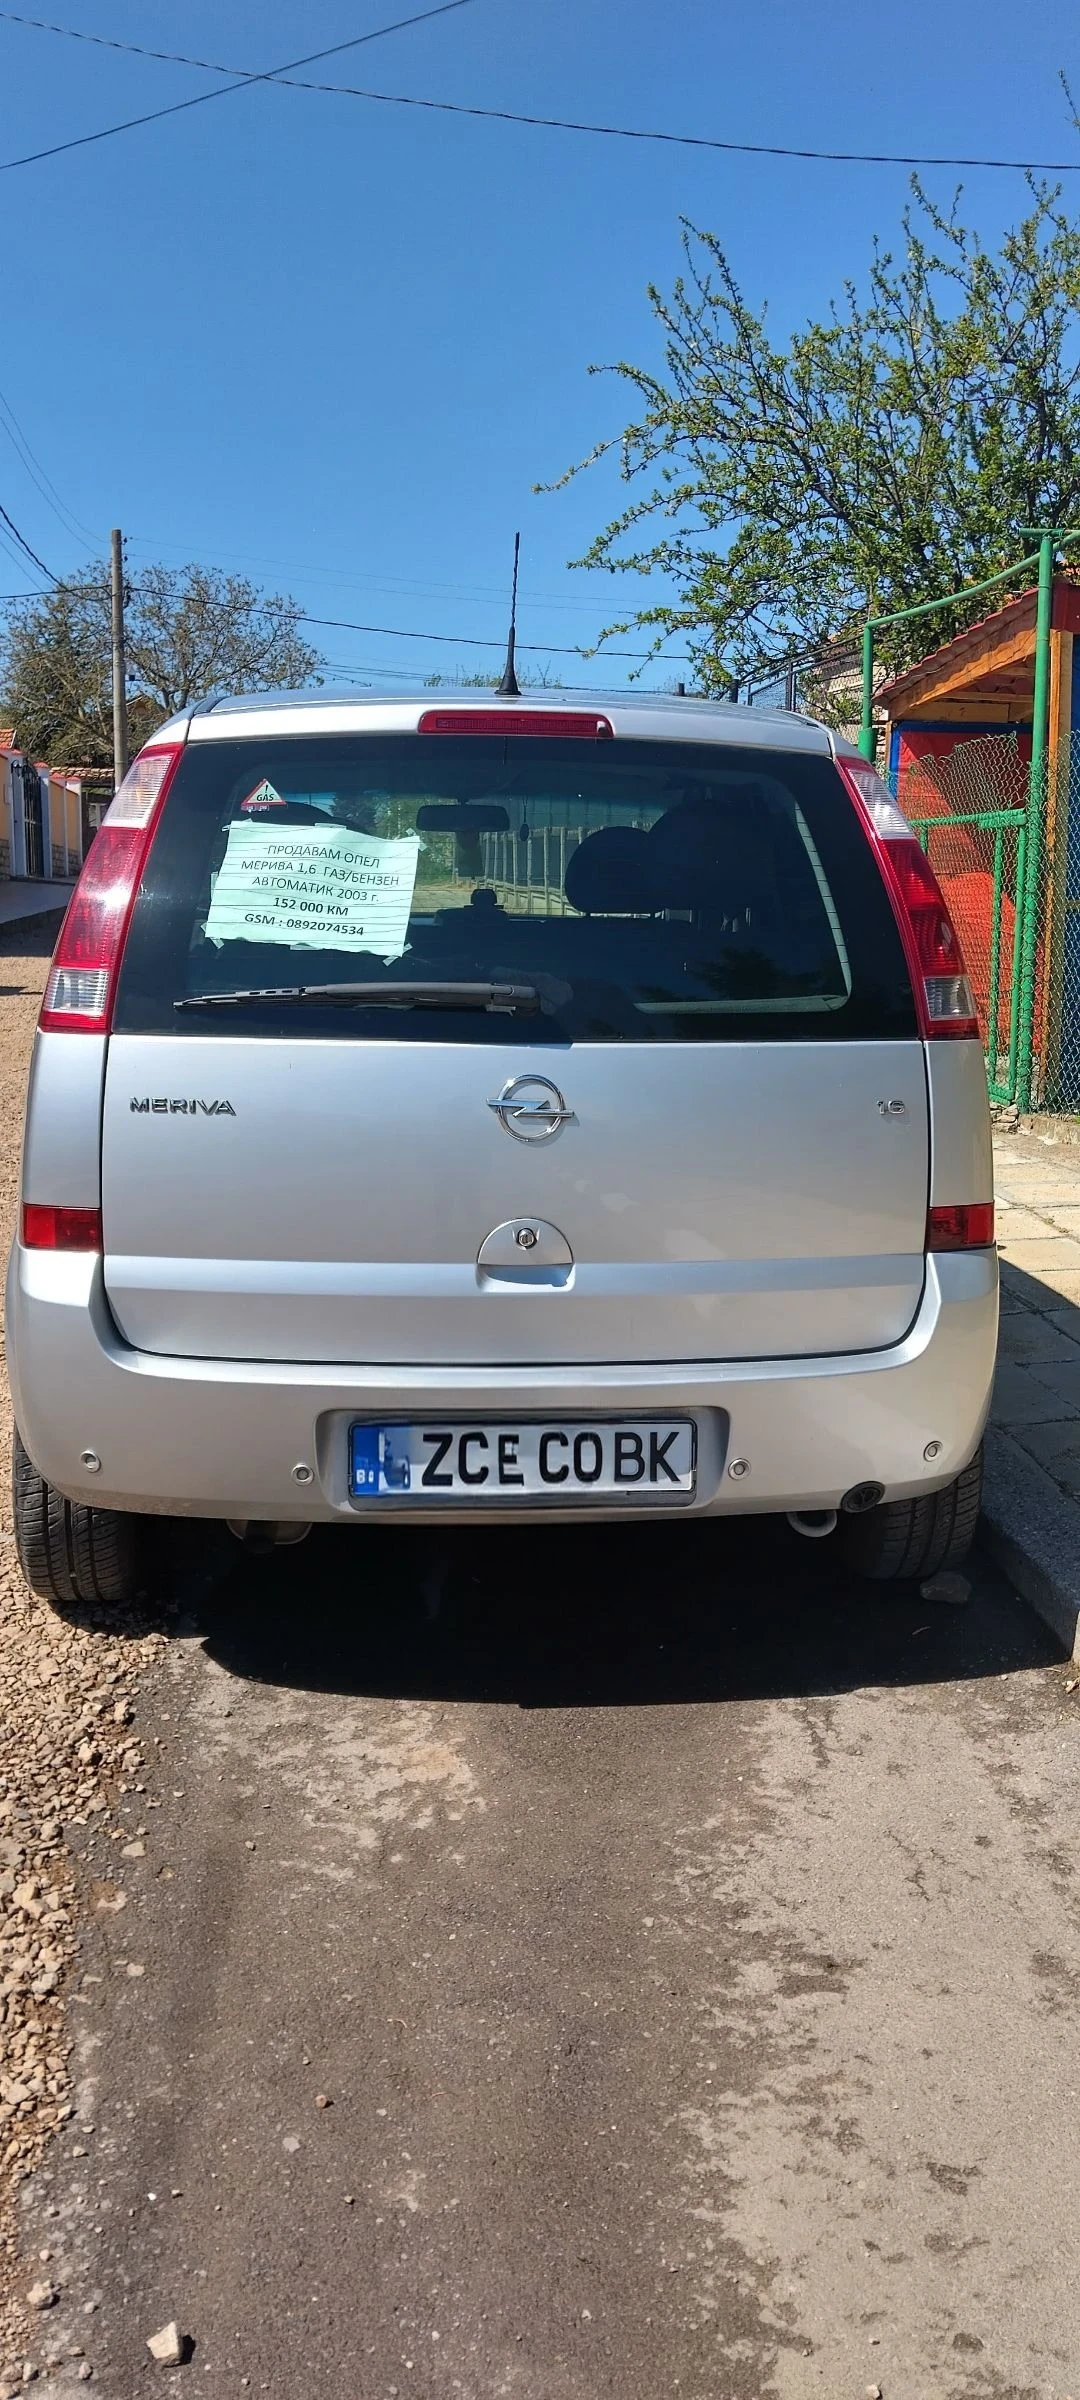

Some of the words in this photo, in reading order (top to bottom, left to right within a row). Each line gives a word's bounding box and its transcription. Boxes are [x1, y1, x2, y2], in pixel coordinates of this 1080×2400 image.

[256, 793, 274, 802] GAS
[344, 853, 380, 868] ОПЕЛ
[241, 860, 294, 871] МЕРИВА
[297, 863, 317, 875] 1,6
[322, 866, 400, 886] ГАЗ/БЕНЗЕН
[251, 876, 334, 896] АВТОМАТИК
[336, 889, 368, 901] 2003
[272, 897, 296, 910] 152
[299, 901, 324, 914] 000
[244, 913, 275, 926] GSM
[286, 918, 365, 936] 0892074534
[129, 1097, 237, 1117] MERIVA
